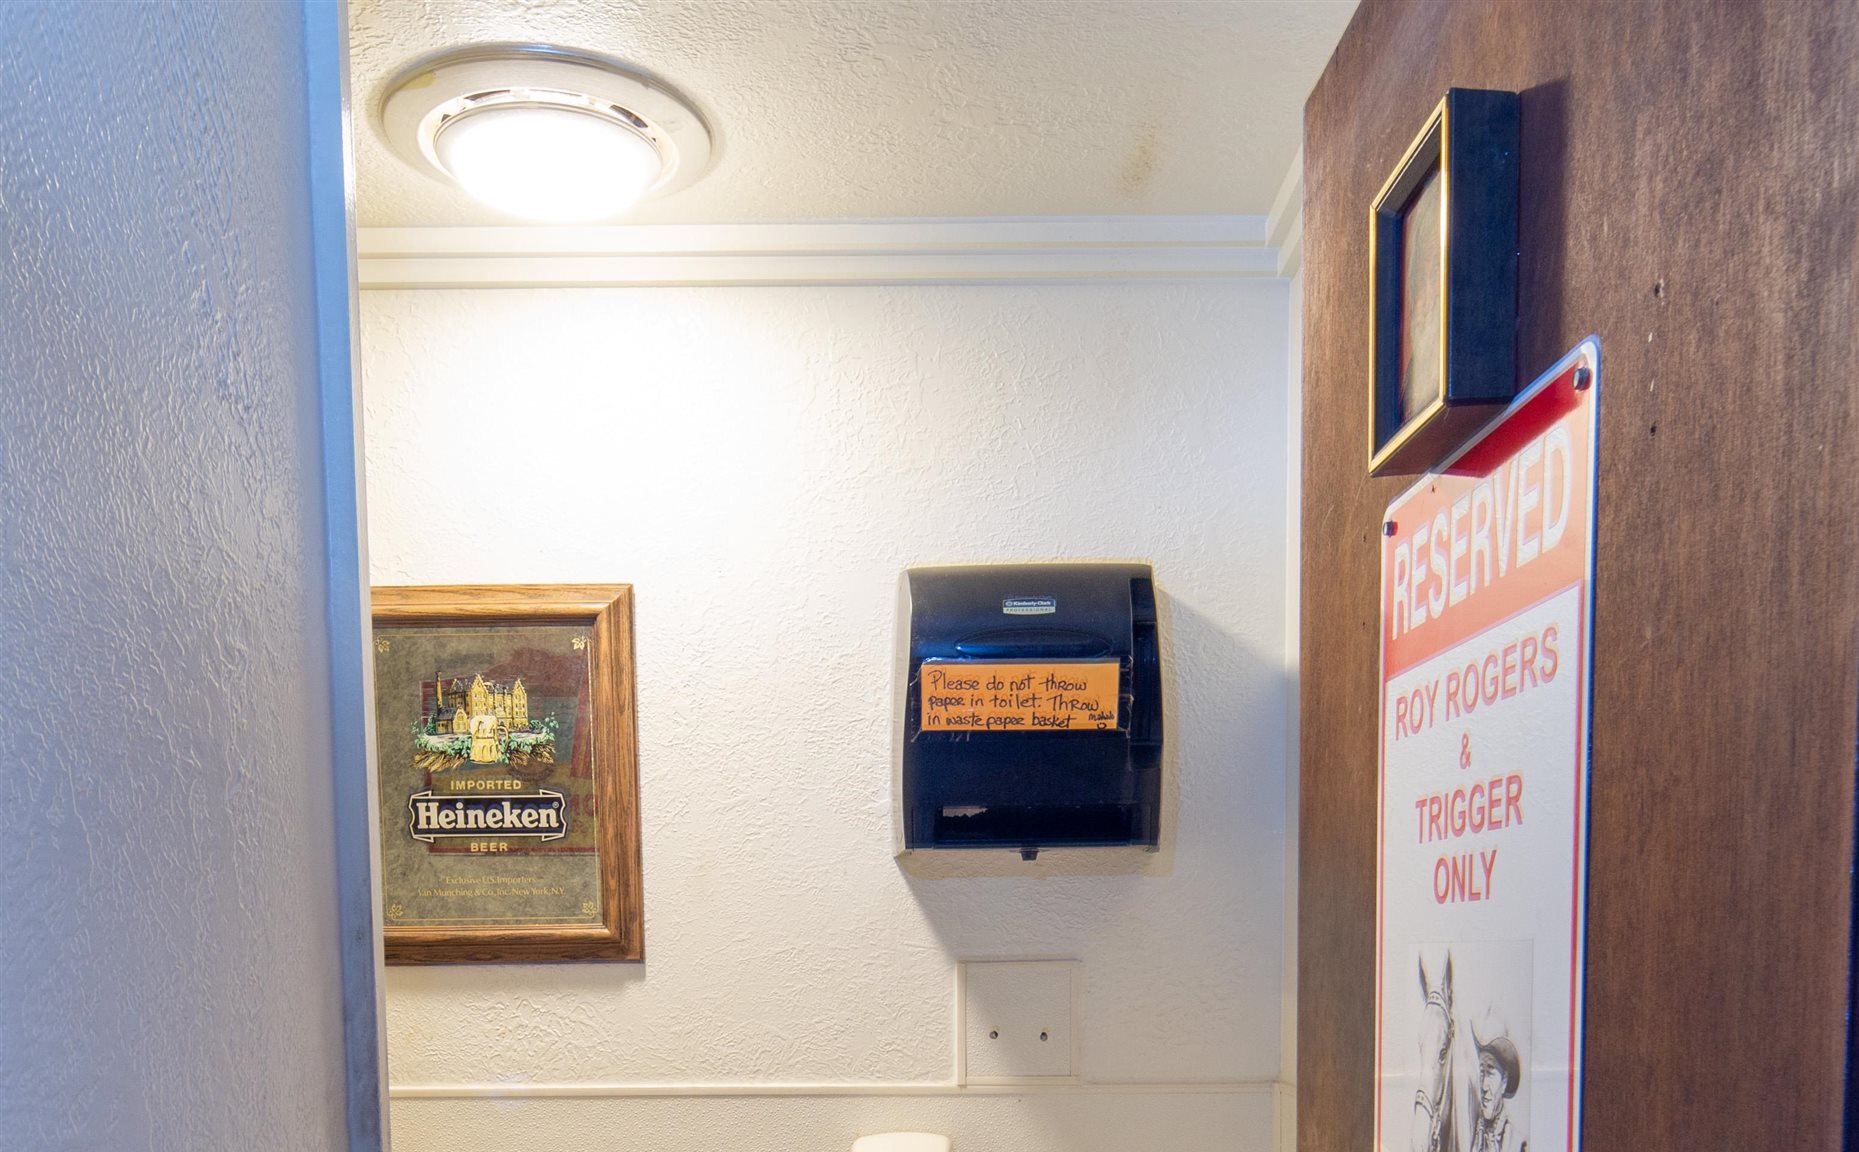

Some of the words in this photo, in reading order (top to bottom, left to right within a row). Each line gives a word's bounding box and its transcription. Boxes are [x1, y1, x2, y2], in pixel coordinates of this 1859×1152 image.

[1392, 425, 1571, 640] RESERVED
[928, 670, 980, 691] Please
[986, 675, 1004, 691] do
[1010, 674, 1035, 691] not
[1395, 679, 1439, 741] ROY
[1446, 626, 1558, 721] ROGERS
[928, 695, 965, 712] paper
[970, 694, 984, 707] in
[989, 693, 1042, 709] toilet.
[1047, 693, 1099, 711] Throw
[927, 713, 941, 726] in
[946, 713, 984, 727] waste
[986, 716, 1025, 729] paper
[1032, 711, 1077, 728] basket
[1460, 733, 1471, 770] &
[450, 780, 522, 790] IMPORTED
[416, 801, 559, 829] Heineken
[1415, 774, 1523, 844] TRIGGER
[470, 842, 508, 852] BEER
[446, 876, 481, 884] Exclusive
[497, 876, 536, 885] Importers
[1433, 850, 1497, 904] ONLY
[474, 888, 481, 896] &
[512, 887, 530, 896] New
